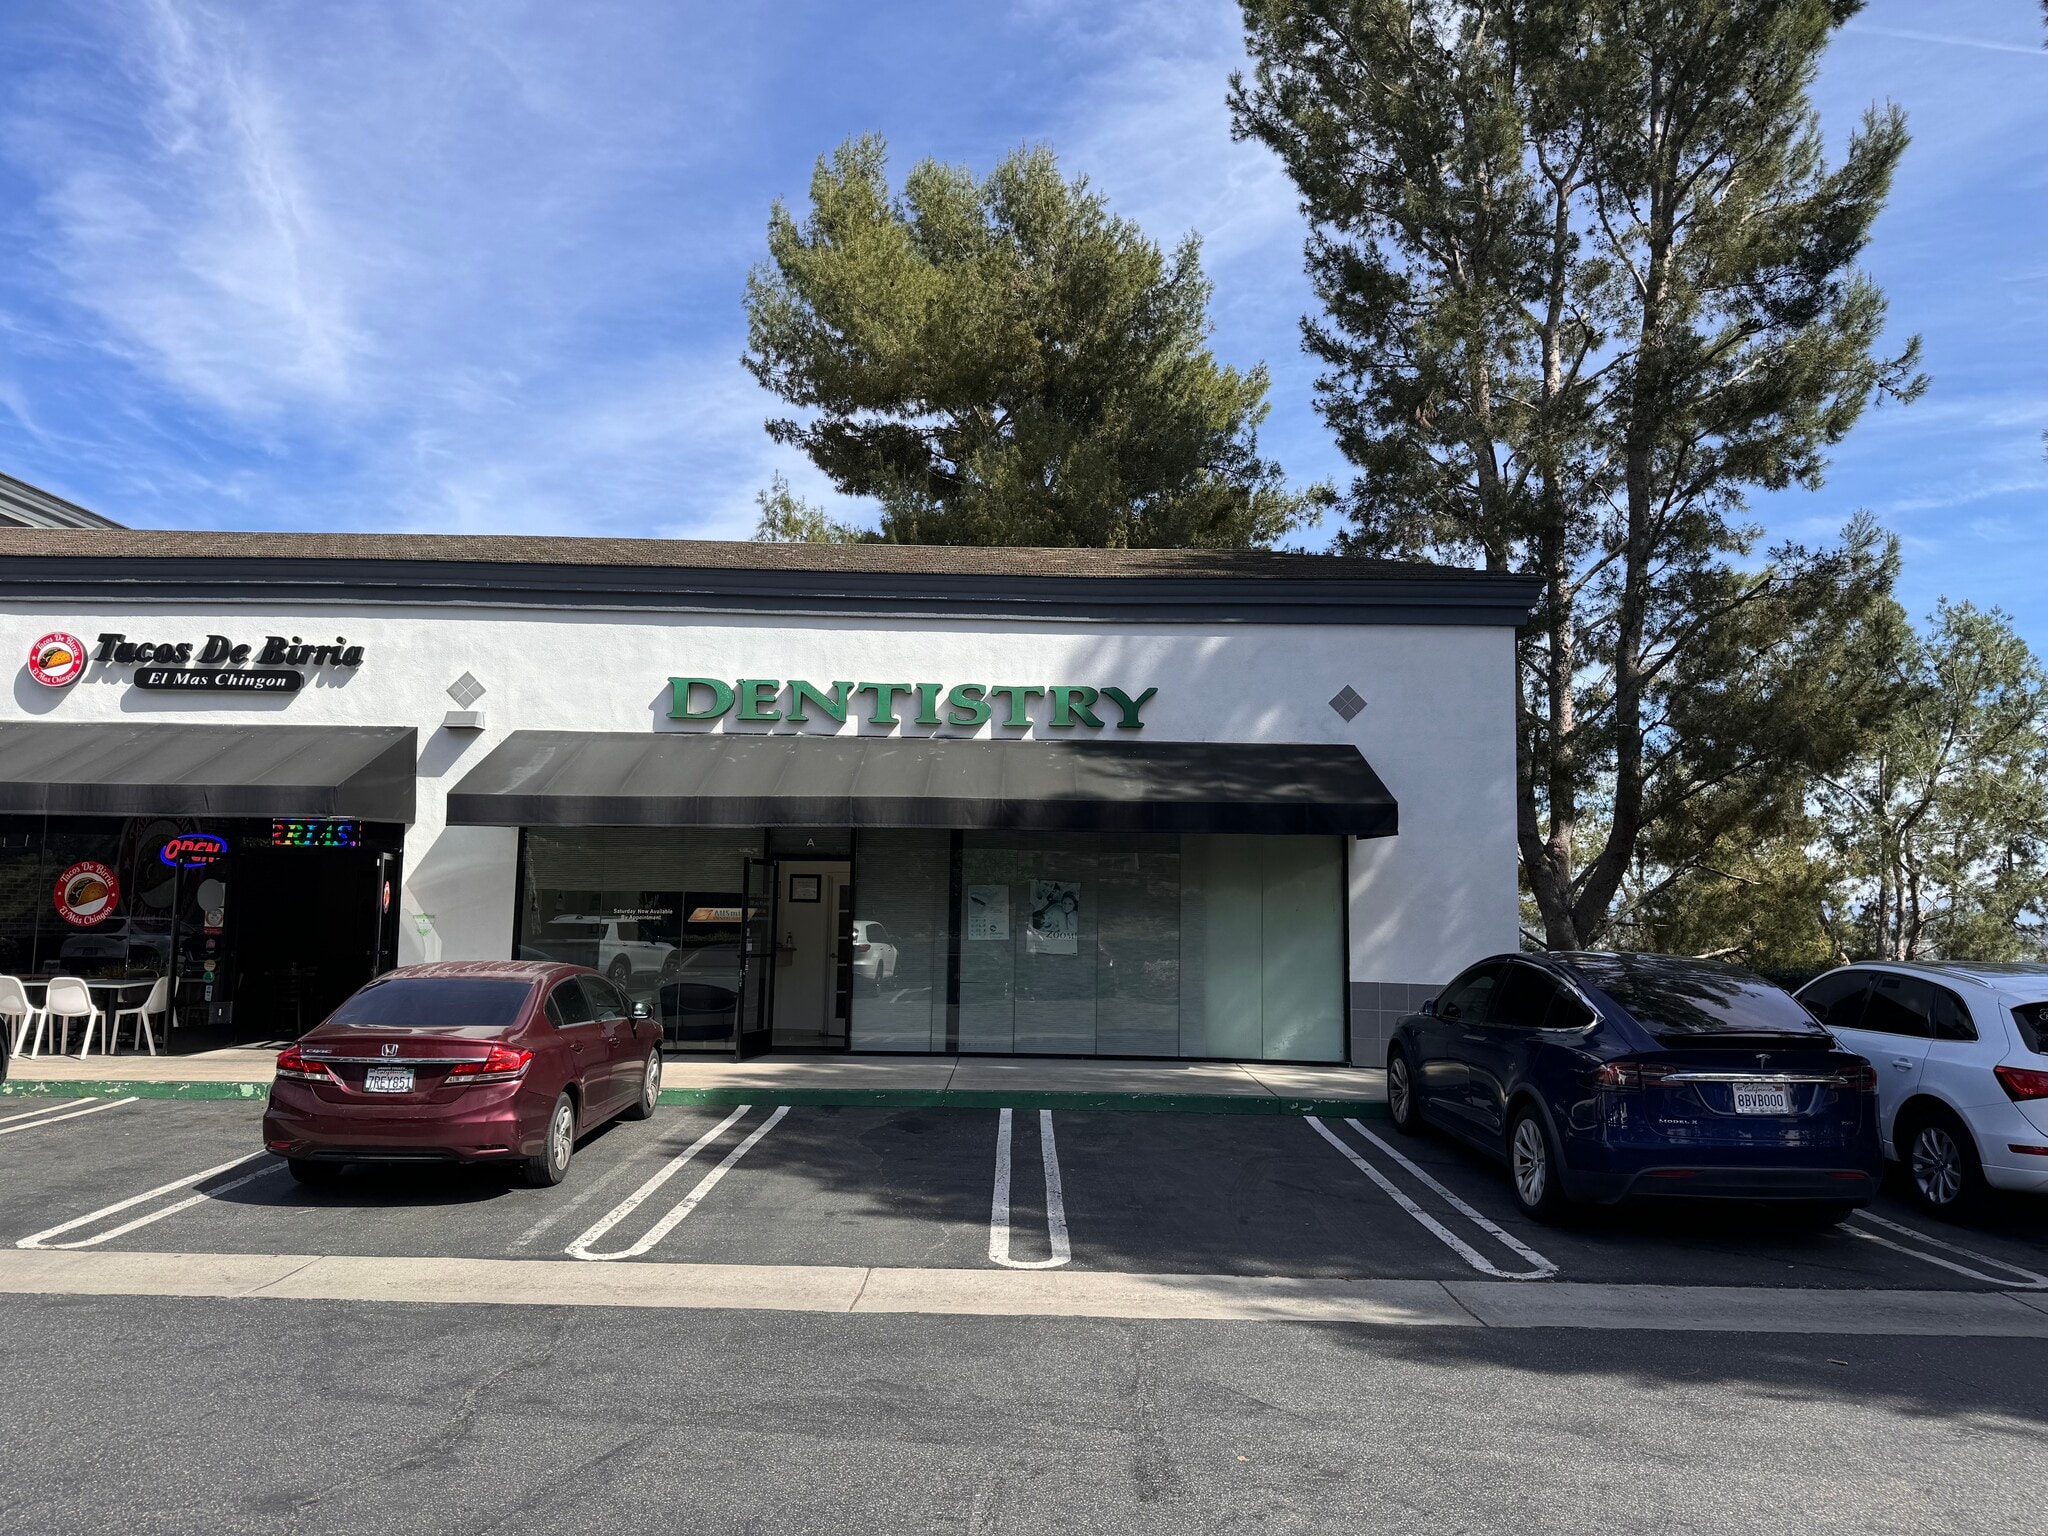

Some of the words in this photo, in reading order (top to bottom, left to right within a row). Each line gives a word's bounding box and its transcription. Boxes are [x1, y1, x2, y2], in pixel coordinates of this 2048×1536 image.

[35, 637, 53, 650] Tacos
[66, 637, 80, 657] Birria
[93, 633, 193, 664] Tacos
[197, 634, 251, 664] De
[256, 635, 365, 667] Birria
[148, 672, 166, 684] El
[181, 673, 209, 685] Mas
[215, 674, 287, 689] Chingon
[665, 676, 1159, 729] DENTISTRY
[806, 837, 815, 847] A
[165, 839, 221, 863] OPEN
[60, 866, 81, 883] Tacos
[81, 861, 94, 871] De
[96, 863, 115, 887] Birria
[59, 905, 69, 916] El
[613, 908, 636, 916] Saturday
[368, 1076, 411, 1090] 7REY851
[1744, 1085, 1775, 1093] California
[1737, 1094, 1784, 1107] 8BVB000
